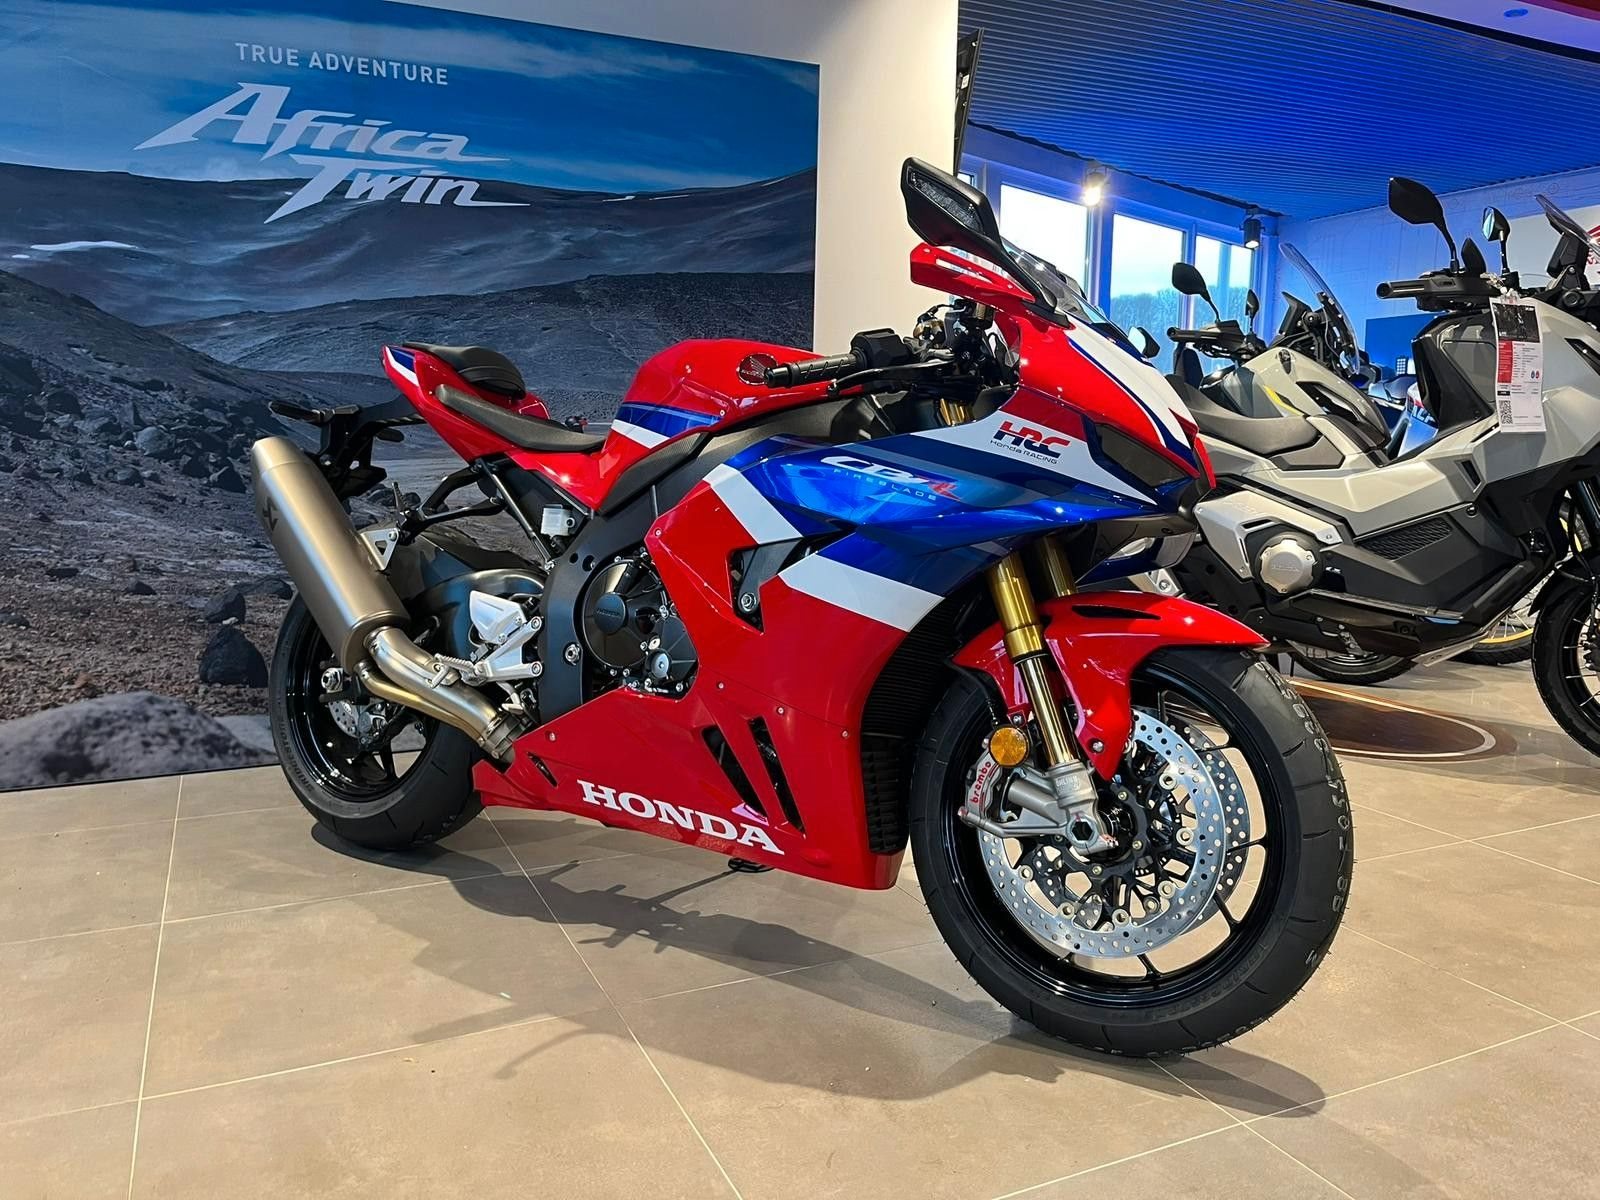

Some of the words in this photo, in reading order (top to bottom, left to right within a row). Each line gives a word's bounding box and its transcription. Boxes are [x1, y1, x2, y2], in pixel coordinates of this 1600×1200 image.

[235, 43, 299, 66] TRUE
[309, 51, 449, 85] ADVENTURE
[133, 82, 511, 161] Africa
[264, 153, 531, 224] Twin
[993, 420, 1071, 458] HRC
[1023, 450, 1058, 464] RACING
[833, 468, 937, 500] FIREBLADE
[970, 761, 992, 803] brembo
[577, 779, 785, 855] HONDA
